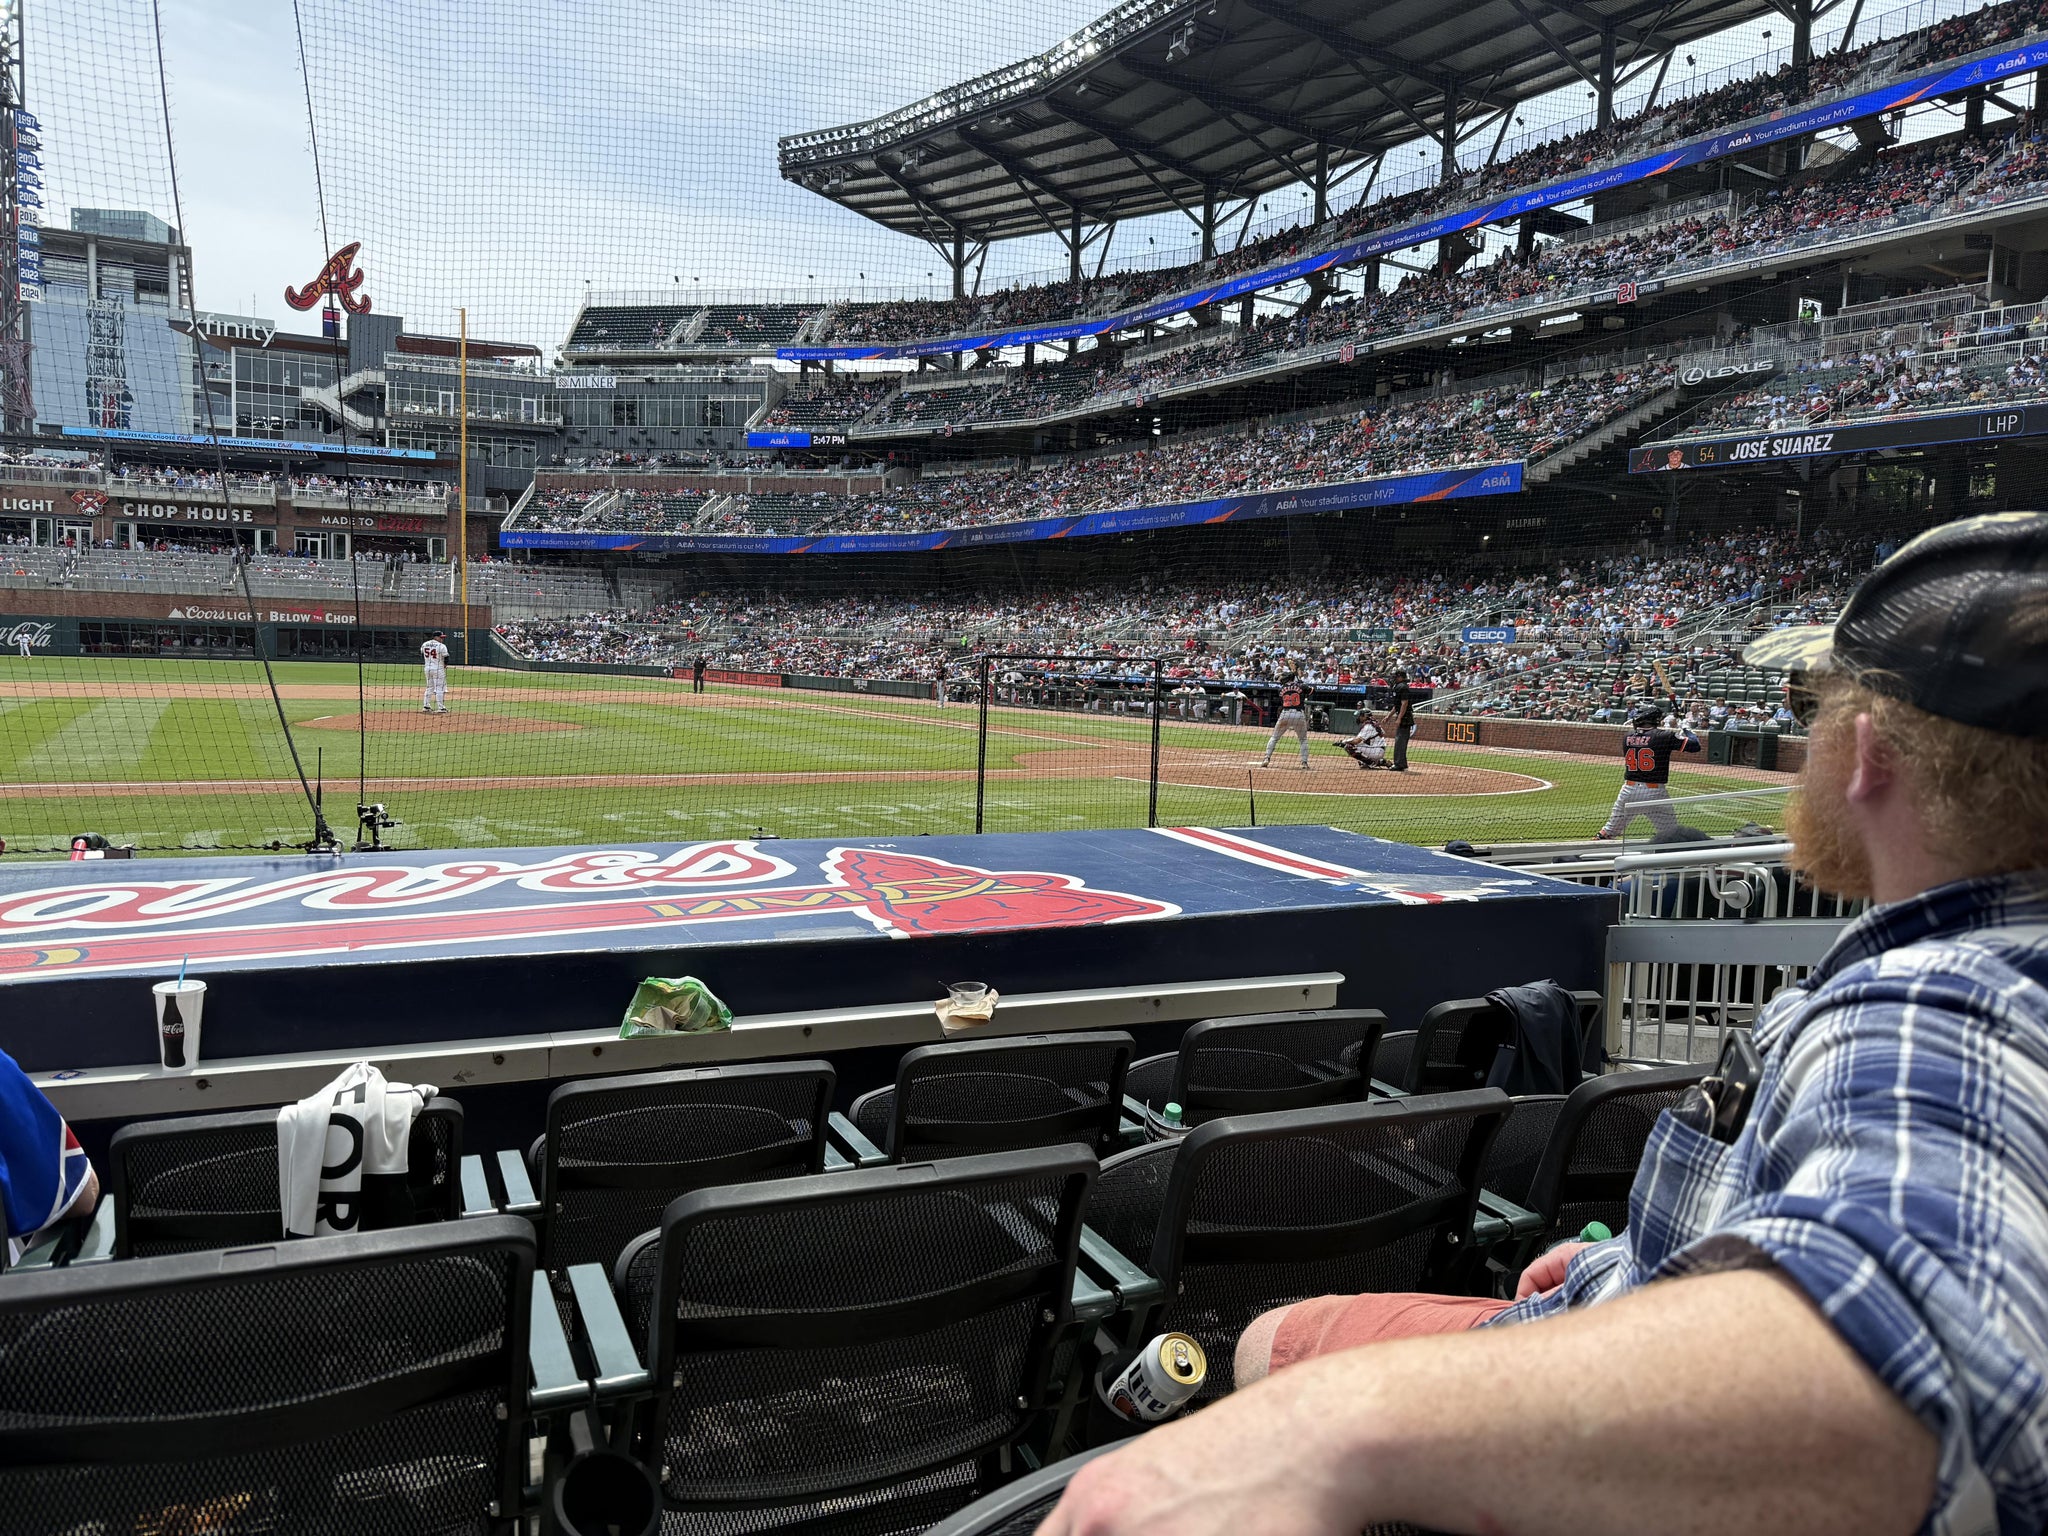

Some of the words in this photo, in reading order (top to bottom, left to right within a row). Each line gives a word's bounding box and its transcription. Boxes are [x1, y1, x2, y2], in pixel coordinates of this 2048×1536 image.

[1995, 54, 2026, 72] ABM
[1728, 133, 1751, 148] ABM
[1755, 131, 1772, 140] Your
[1774, 120, 1807, 135] stadium
[1808, 117, 1815, 126] is
[1817, 114, 1832, 123] our
[1833, 105, 1855, 118] MVP
[18, 133, 37, 146] 1999
[19, 172, 37, 185] 2003
[1526, 193, 1544, 206] ABM
[1560, 185, 1586, 196] stadium
[1605, 172, 1622, 183] MVP
[20, 191, 38, 204] 2005
[20, 211, 37, 224] 2012
[20, 230, 38, 242] 2018
[1366, 241, 1381, 252] ABM
[1394, 234, 1415, 244] stadium
[1430, 224, 1444, 234] MVP
[21, 249, 38, 262] 2020
[21, 268, 39, 280] 2022
[21, 287, 39, 299] 2024
[1594, 291, 1617, 303] WARREN
[1617, 282, 1637, 304] 21
[1638, 284, 1658, 294] SPAHN
[185, 313, 278, 347] xfinity
[1339, 344, 1354, 363] 10
[1706, 361, 1774, 379] LEXUS
[570, 377, 614, 388] MILNER
[944, 425, 952, 438] 3
[770, 436, 789, 444] ABM
[813, 436, 829, 444] 2:47
[832, 436, 845, 444] PM
[1700, 447, 1714, 462] 54
[1729, 437, 1770, 460] JOSÉ
[1772, 434, 1834, 456] SUAREZ
[1987, 415, 2018, 433] LHP
[1481, 472, 1510, 488] ABM
[2, 498, 54, 512] LIGHT
[1275, 496, 1297, 511] ABM
[1300, 498, 1317, 507] Your
[1319, 494, 1350, 505] stadium
[1351, 493, 1357, 502] is
[1358, 492, 1372, 501] our
[1374, 488, 1395, 500] MVP
[123, 503, 178, 518] CHOP
[187, 507, 253, 522] HOUSE
[321, 516, 355, 526] MADE
[358, 517, 374, 526] TO
[1101, 517, 1116, 528] ABM
[1132, 516, 1153, 526] stadium
[1154, 515, 1159, 523] is
[1170, 512, 1185, 520] MVP
[506, 536, 523, 544] ABM
[677, 540, 695, 548] ABM
[185, 605, 226, 620] Coors
[269, 611, 311, 623] BELOW
[325, 612, 357, 624] CHOP
[1469, 631, 1506, 640] GEICO
[424, 648, 437, 659] 54
[1447, 723, 1475, 742] 0:05
[1625, 748, 1655, 771] 46
